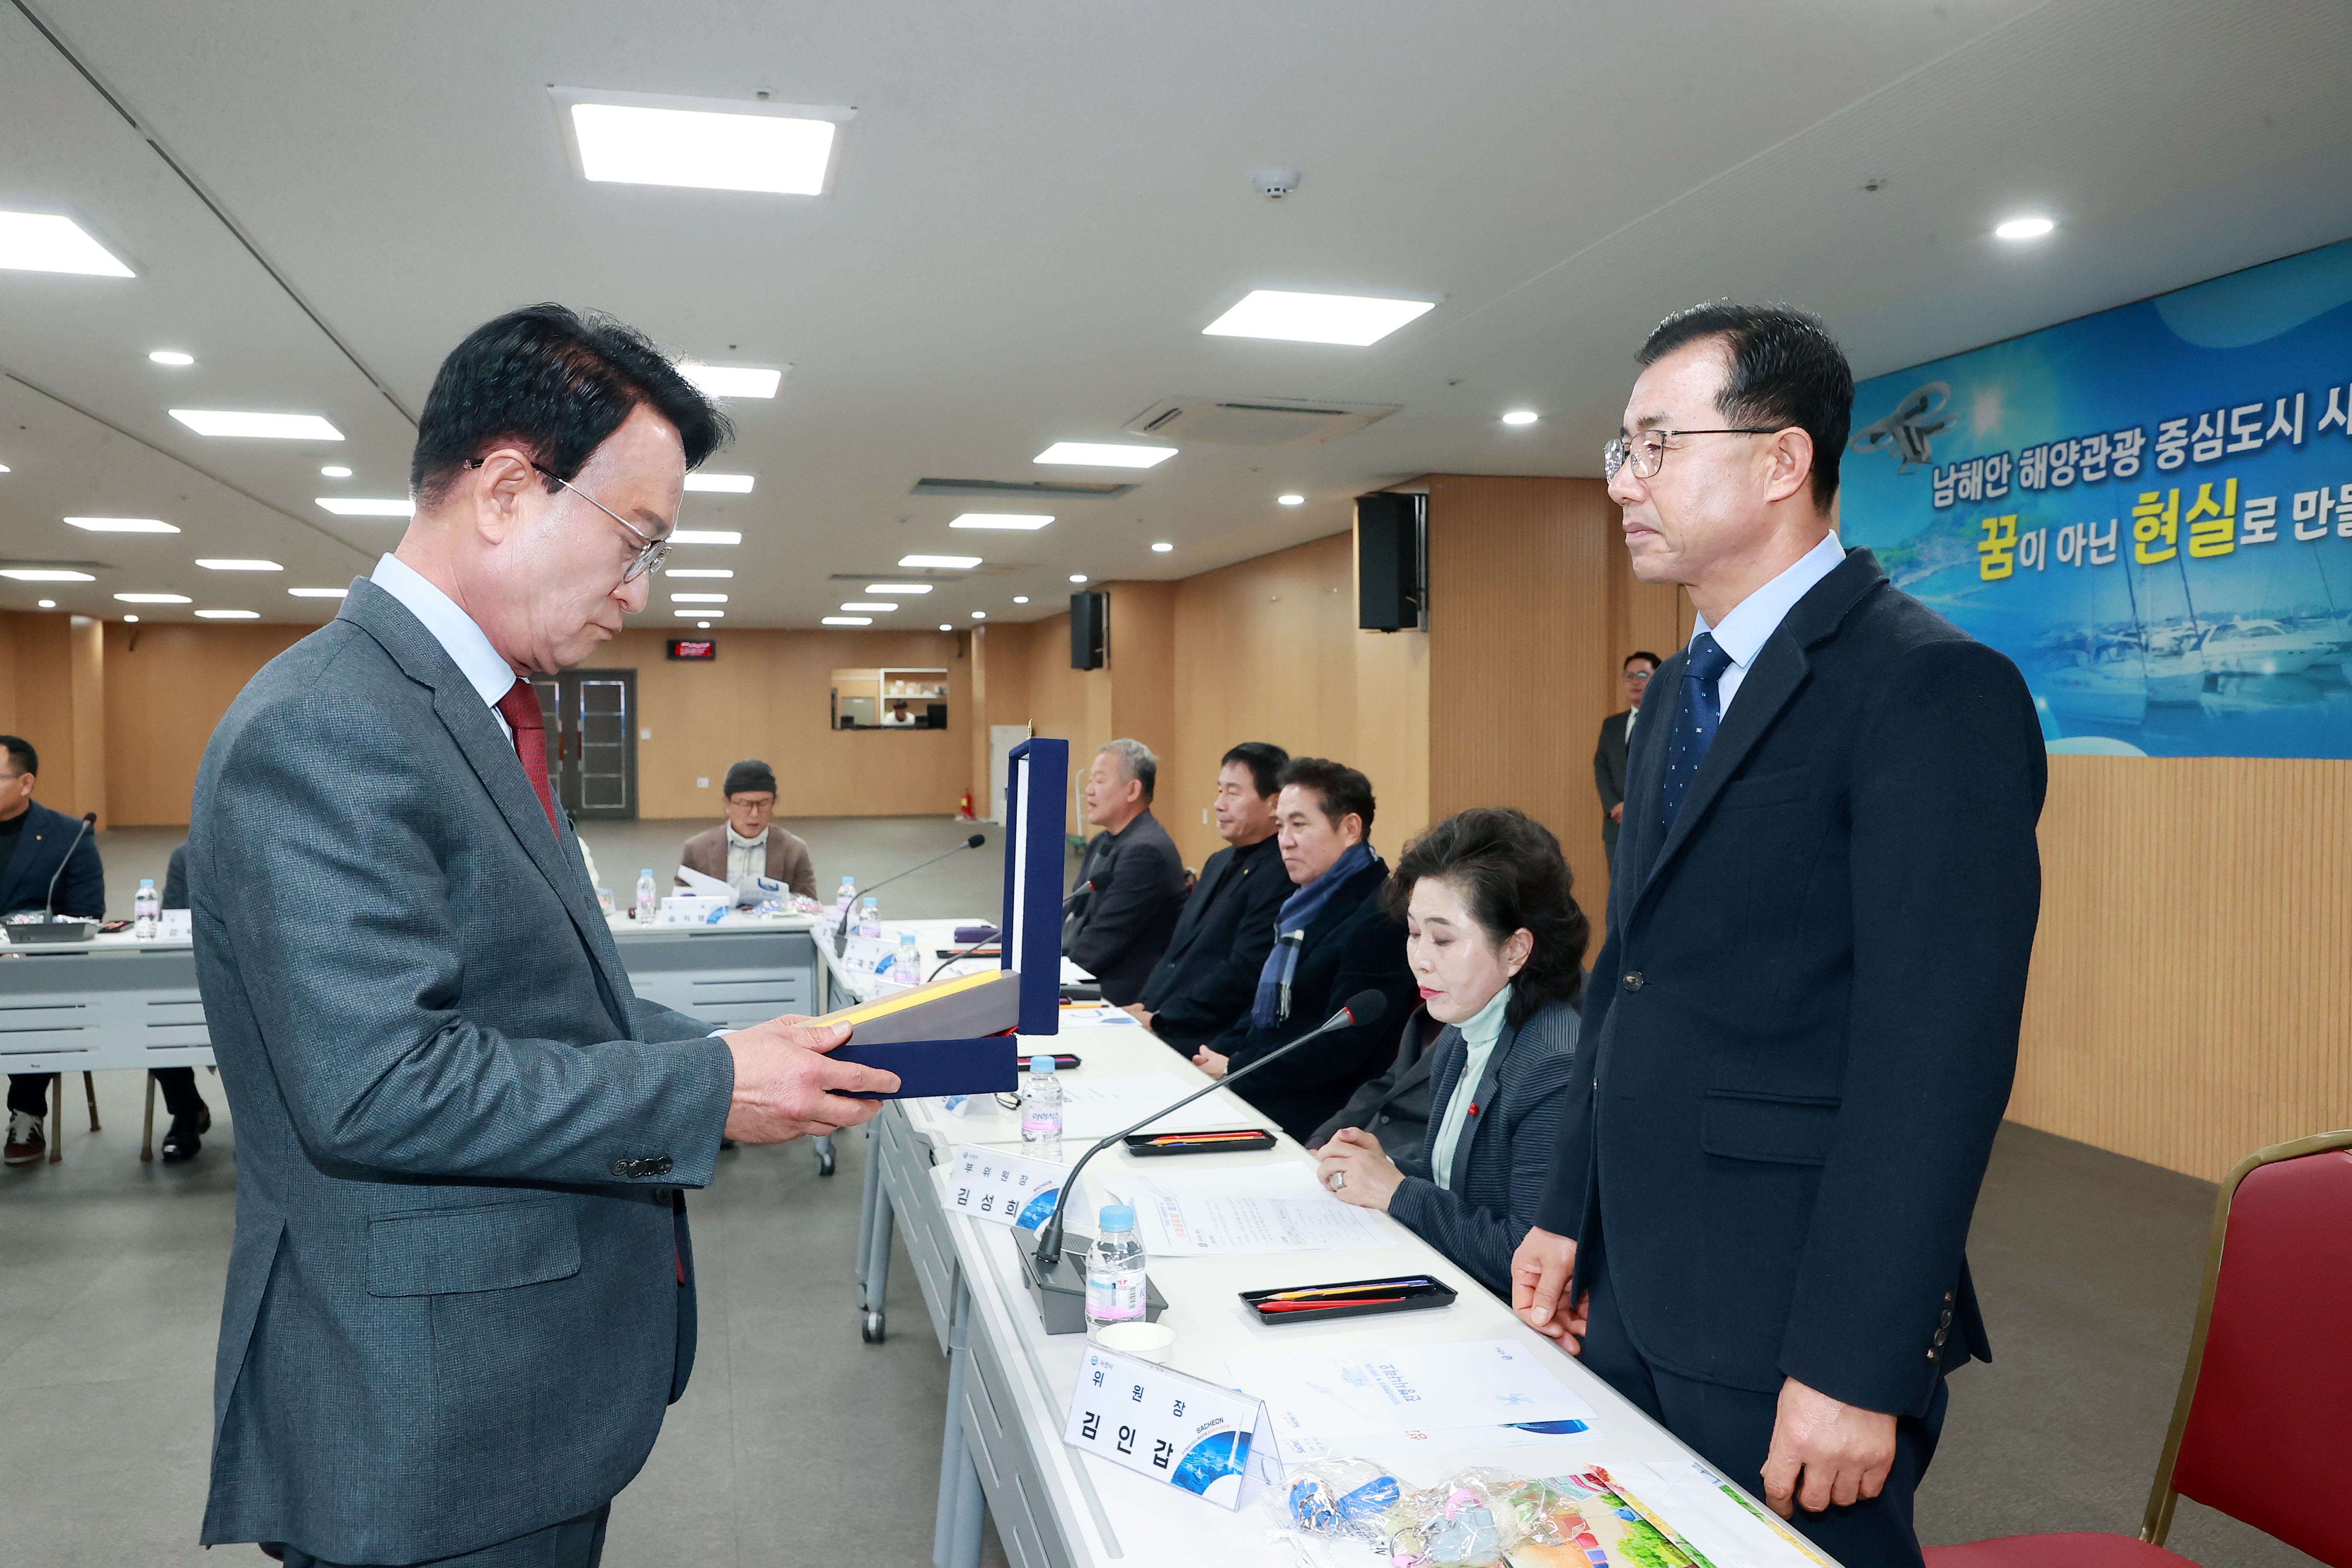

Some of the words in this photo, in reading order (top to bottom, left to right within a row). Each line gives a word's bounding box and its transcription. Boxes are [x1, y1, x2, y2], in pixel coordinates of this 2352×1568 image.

[1933, 453, 2011, 508] 남해안
[2019, 428, 2145, 489] 해양관광
[2155, 393, 2304, 470] 중심도시
[1977, 514, 2046, 581] 꿈이
[2056, 518, 2117, 567] 아닌
[2131, 478, 2278, 565] 현실로
[1379, 1364, 1421, 1402] 진행시나리오
[1196, 1417, 1224, 1434] SACHEON
